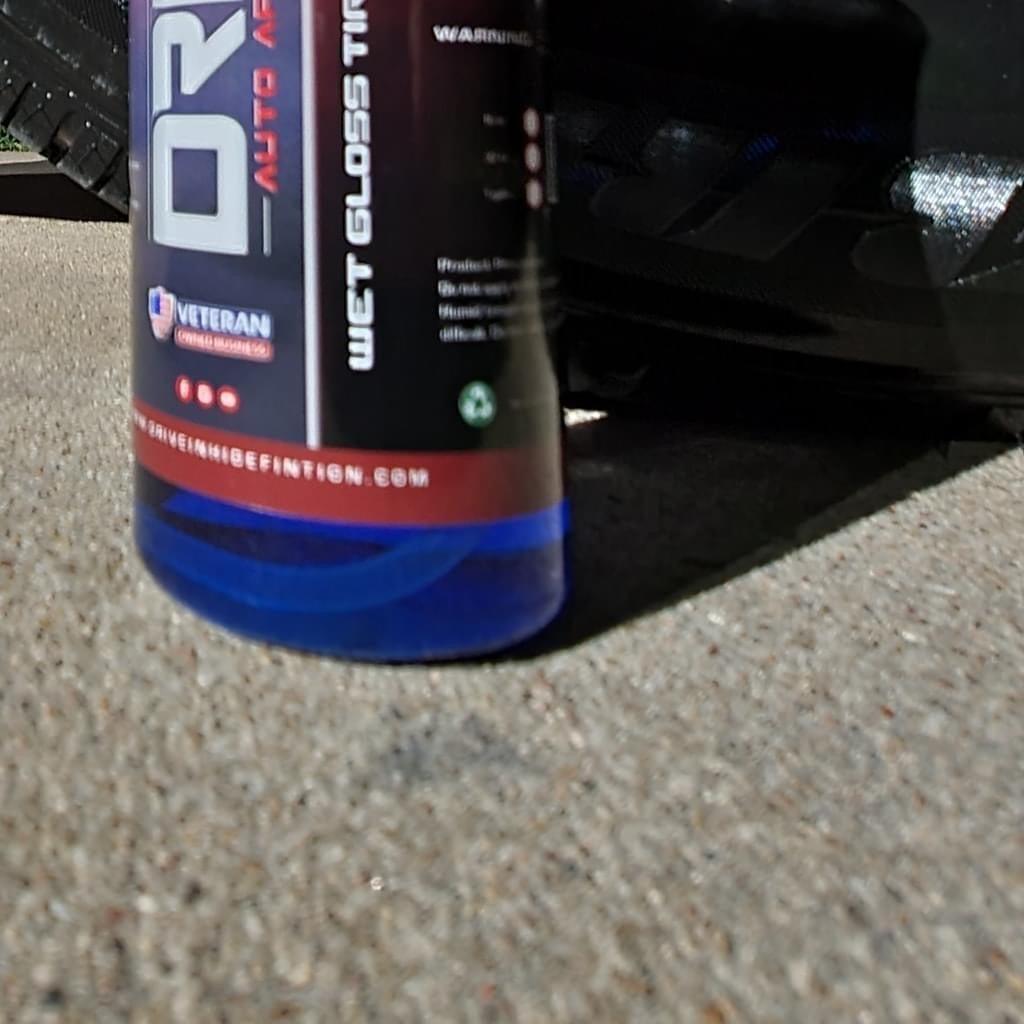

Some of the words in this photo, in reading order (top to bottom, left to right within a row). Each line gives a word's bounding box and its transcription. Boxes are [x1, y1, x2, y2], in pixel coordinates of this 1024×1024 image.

[253, 67, 278, 194] AUTO
[343, 73, 373, 247] GLOSS
[176, 301, 272, 339] VETERAN
[345, 251, 375, 371] WET
